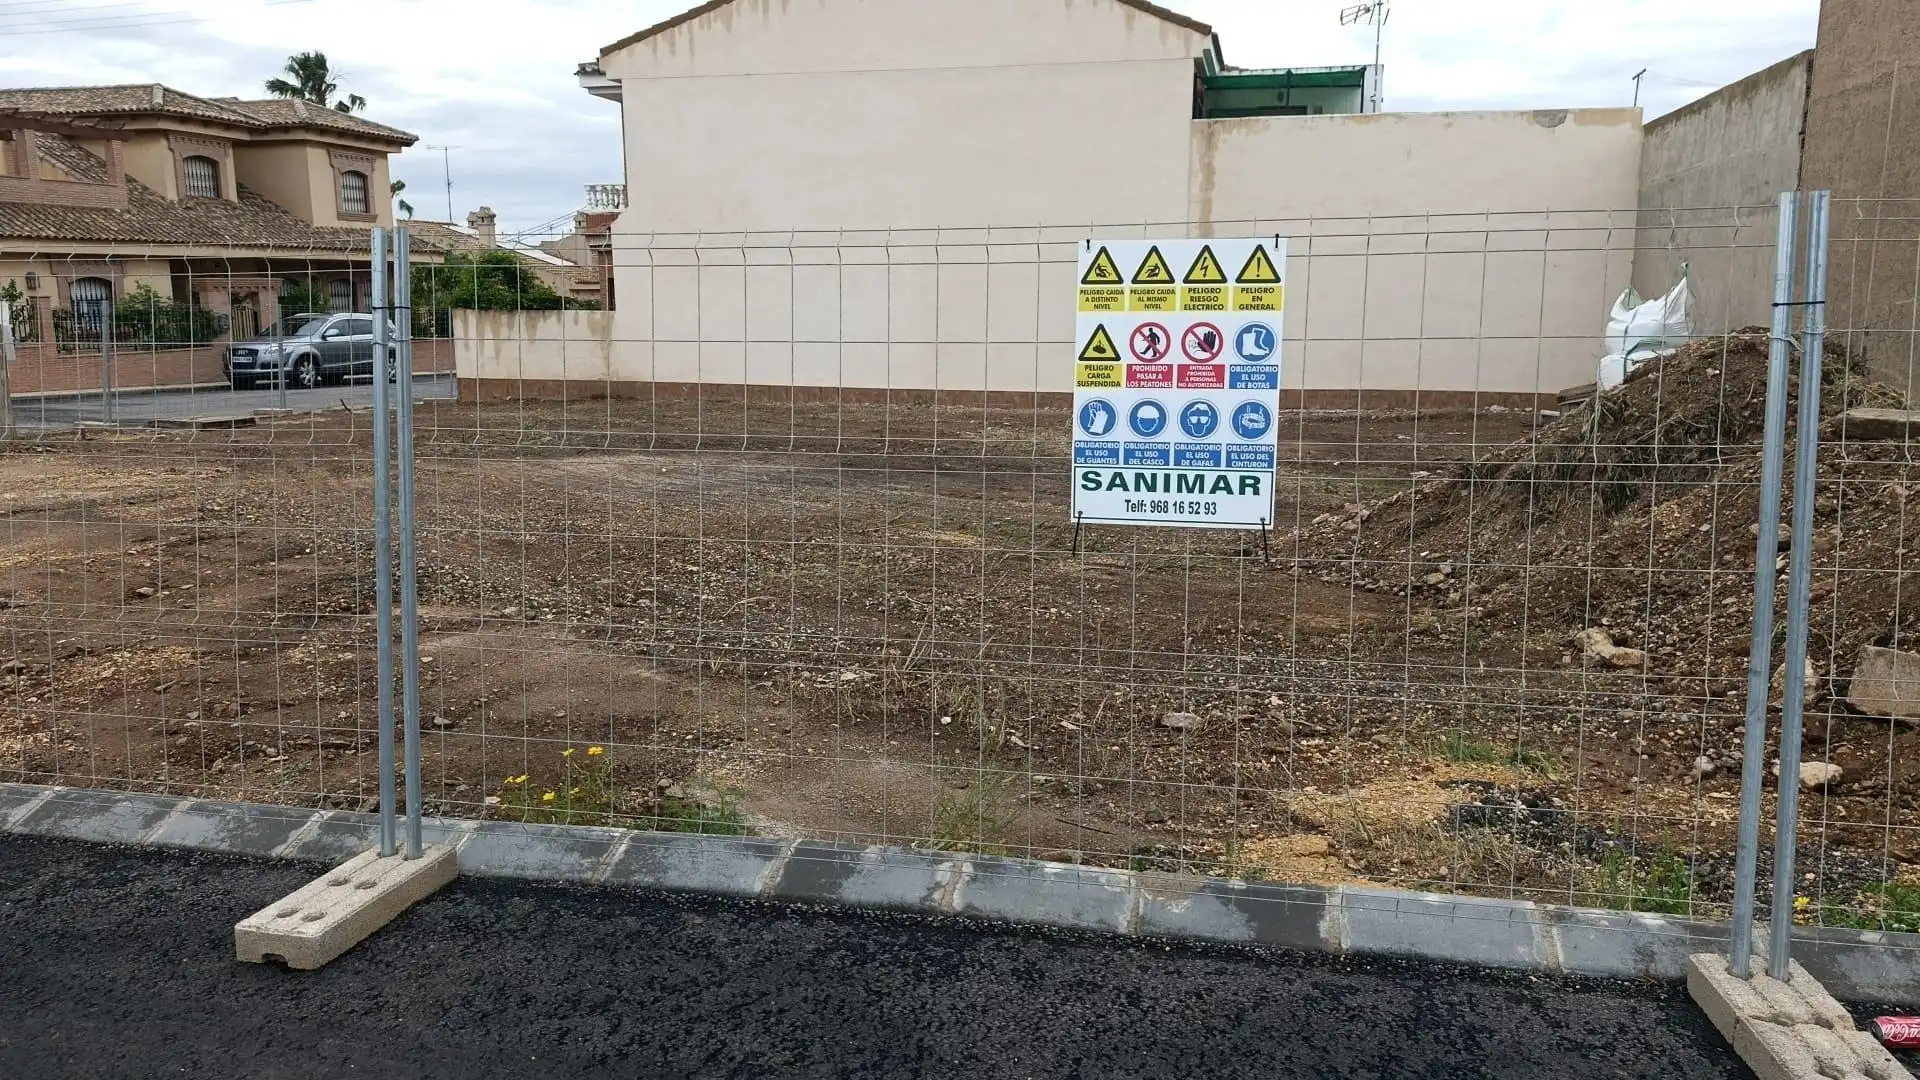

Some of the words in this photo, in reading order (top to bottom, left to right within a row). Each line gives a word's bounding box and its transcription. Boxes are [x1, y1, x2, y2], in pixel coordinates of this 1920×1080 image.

[1081, 470, 1260, 496] SANIMAR
[1125, 500, 1146, 512] Telf:
[1150, 500, 1168, 513] 968
[1173, 501, 1184, 514] 16
[1188, 502, 1200, 514] 52
[1204, 502, 1216, 515] 93
